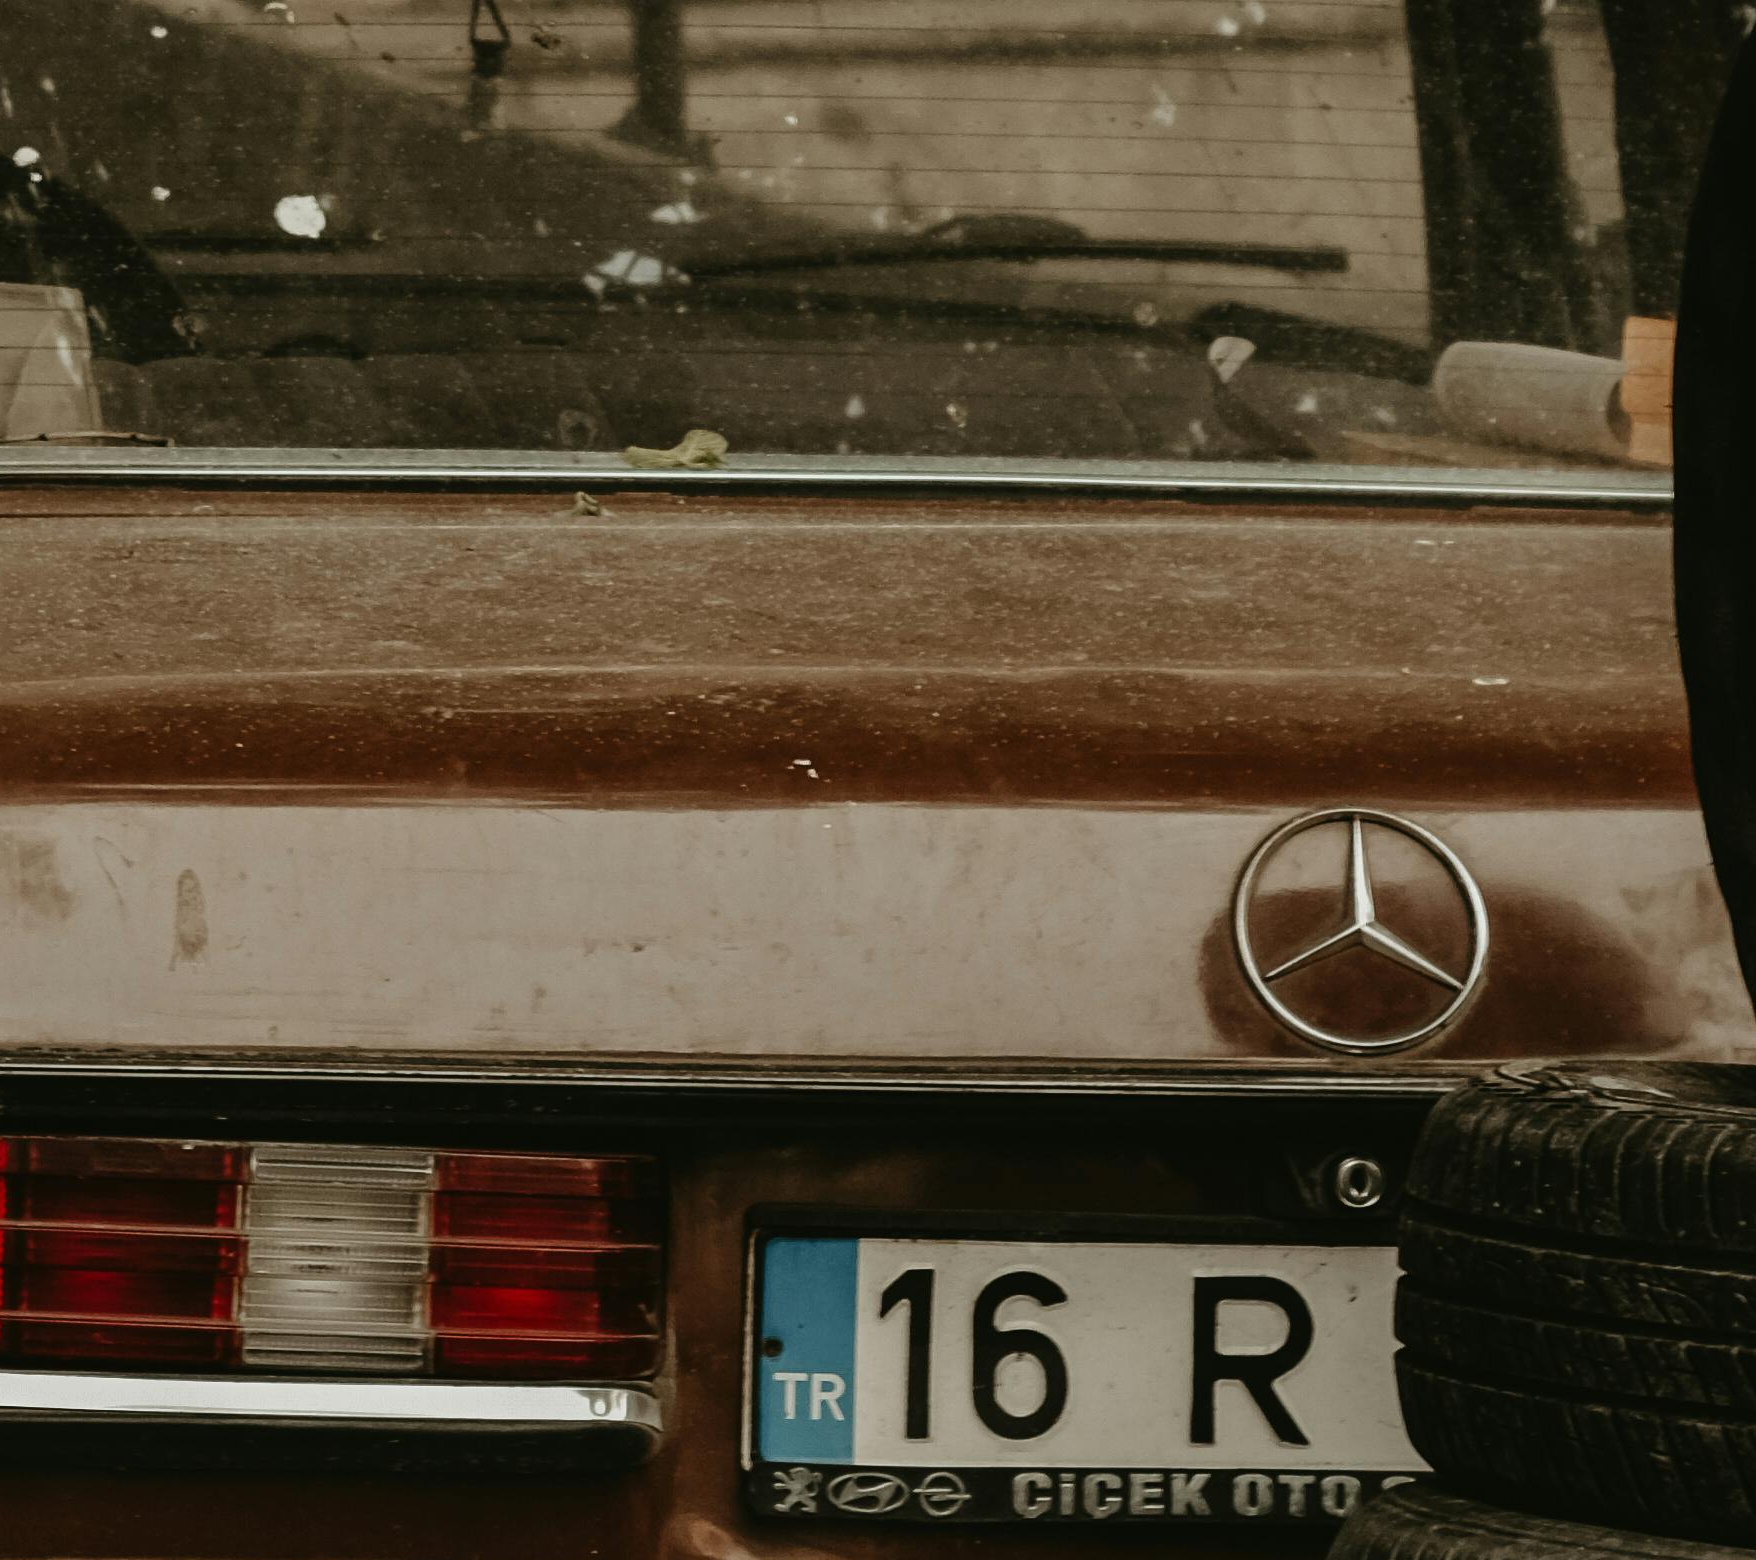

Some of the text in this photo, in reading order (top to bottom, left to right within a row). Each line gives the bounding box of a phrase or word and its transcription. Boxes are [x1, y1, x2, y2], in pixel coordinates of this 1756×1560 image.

[878, 1267, 1315, 1448] 16 R
[771, 1371, 847, 1422] TR
[1231, 1472, 1363, 1518] OTO
